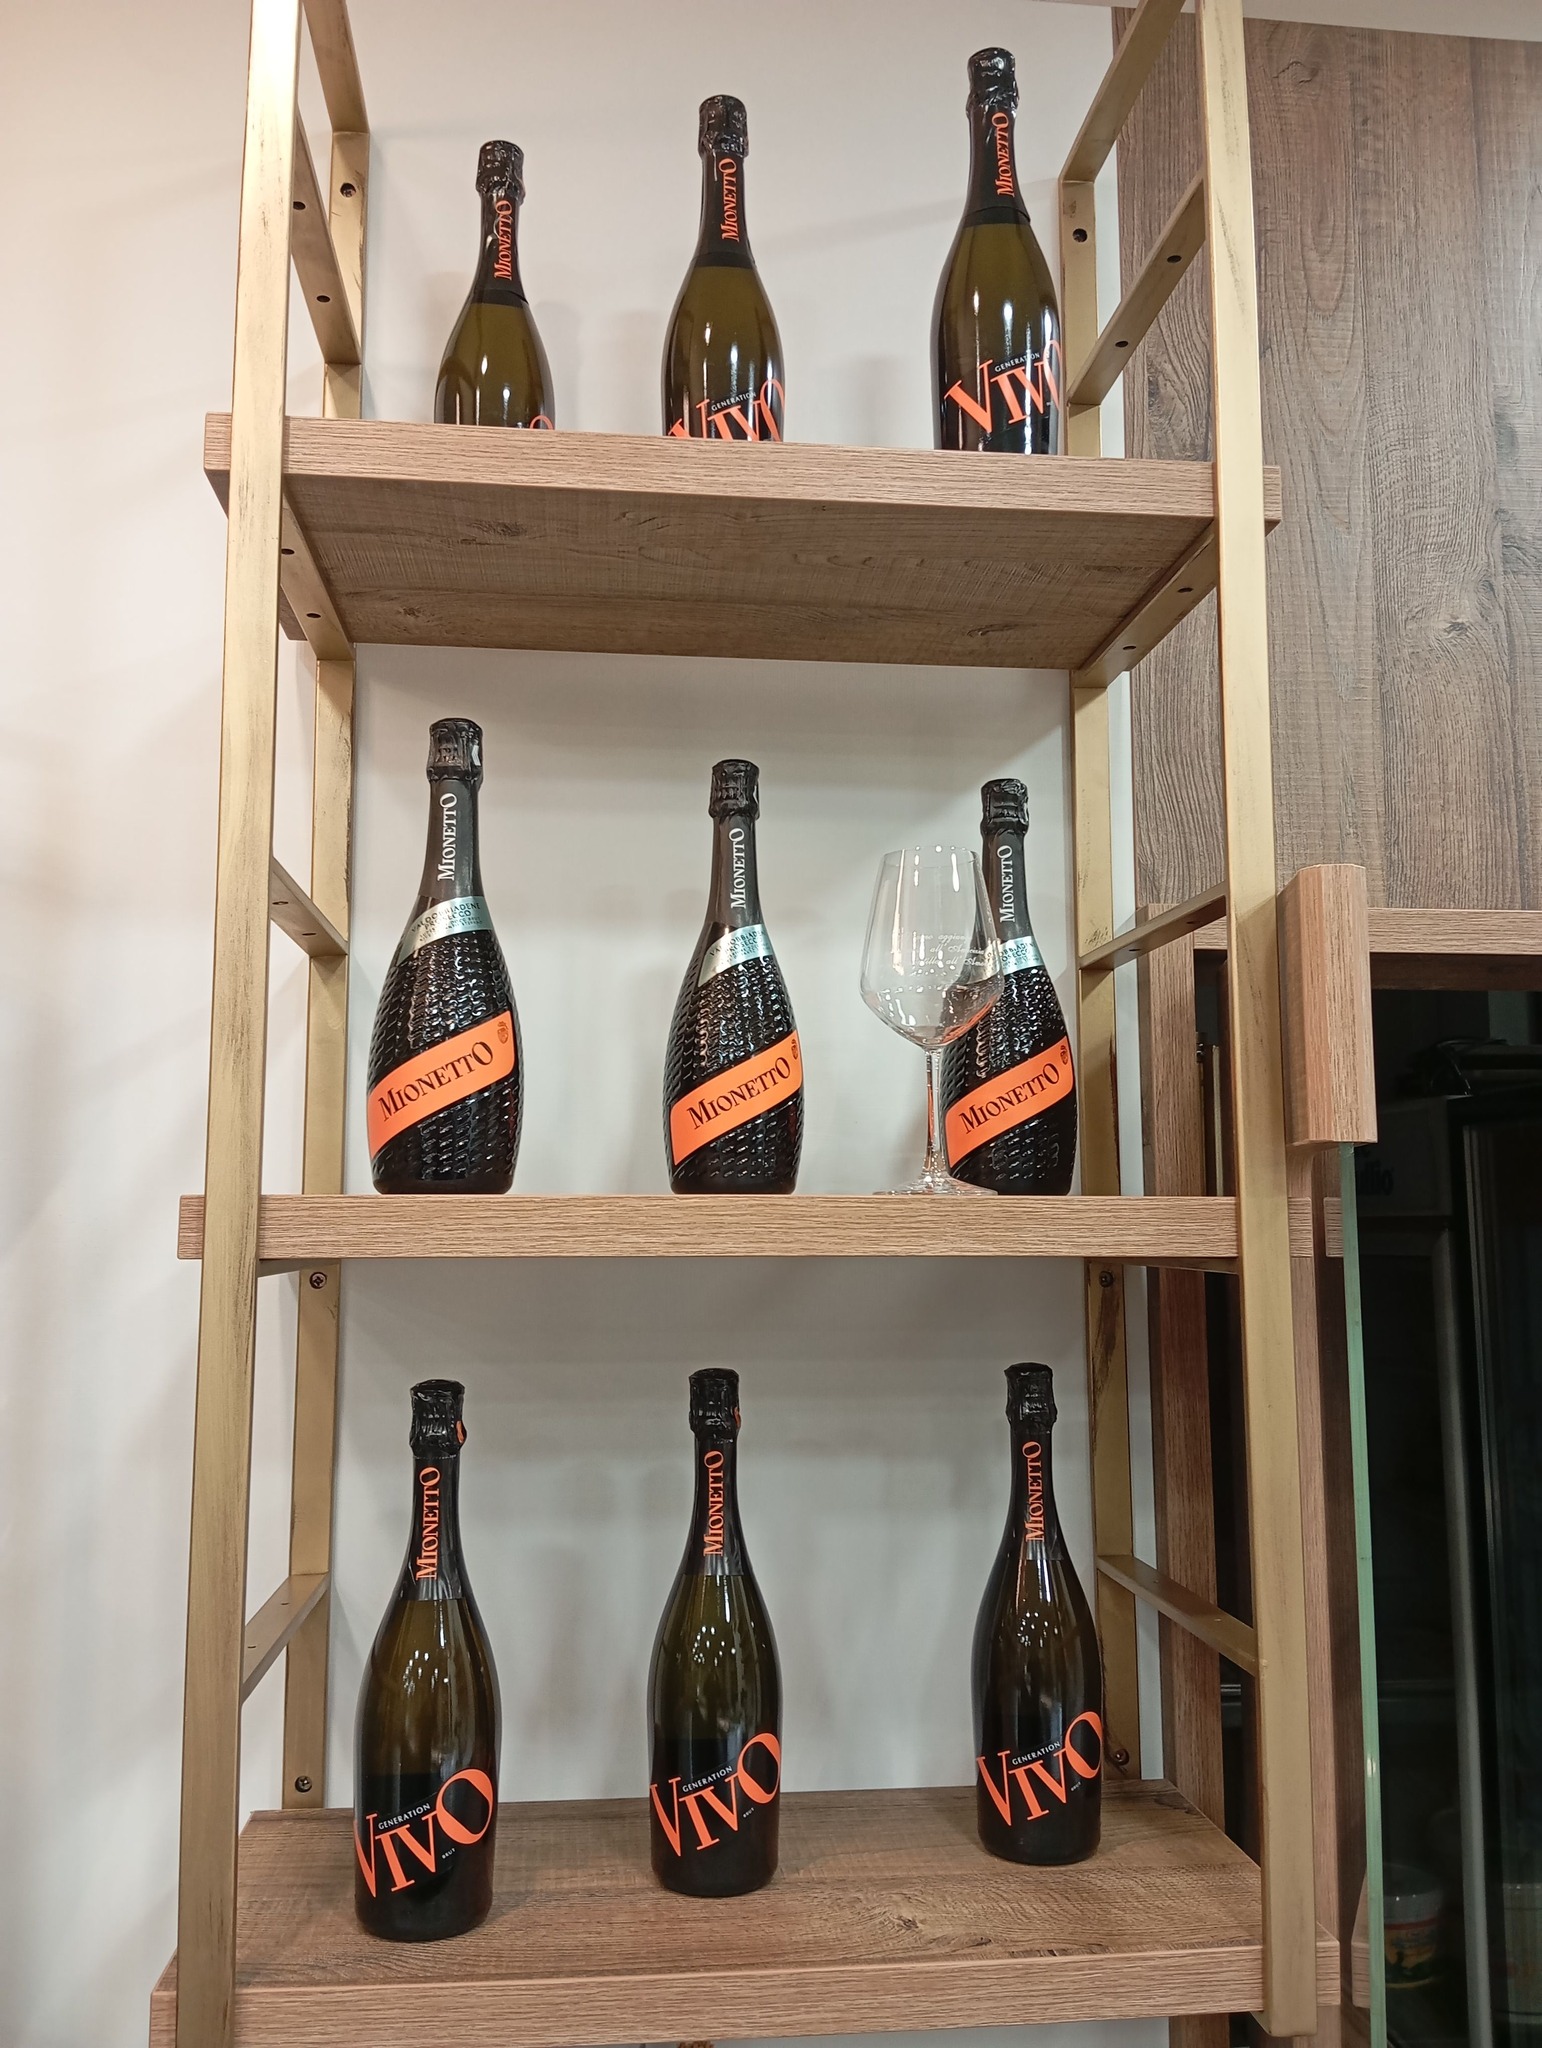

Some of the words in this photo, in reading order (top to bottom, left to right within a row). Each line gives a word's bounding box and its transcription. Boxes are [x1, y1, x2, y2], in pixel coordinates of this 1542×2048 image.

[992, 112, 1014, 197] MIONETTO
[494, 200, 512, 280] MIONETTO
[719, 158, 739, 242] MIONETTO
[711, 391, 757, 411] GENERATION
[994, 352, 1040, 372] GENERATON
[437, 793, 457, 881] MIONETTO
[729, 828, 746, 909] MIONETTO
[997, 845, 1015, 923] MIONETTO
[378, 1041, 493, 1122] MIONETTO
[686, 1056, 791, 1130] MIONETTO
[958, 1063, 1060, 1134] MIONETTO
[416, 1467, 441, 1580] MIONETTO
[703, 1450, 724, 1556] MIONETTO
[1022, 1441, 1045, 1542] MIONETTO
[682, 1765, 733, 1792] GENERATION
[976, 1711, 1103, 1826] VIVO
[1012, 1741, 1061, 1765] GENERATION
[354, 1768, 494, 1898] VIVO
[378, 1803, 431, 1830] GENERATION
[650, 1732, 781, 1857] VIVO
